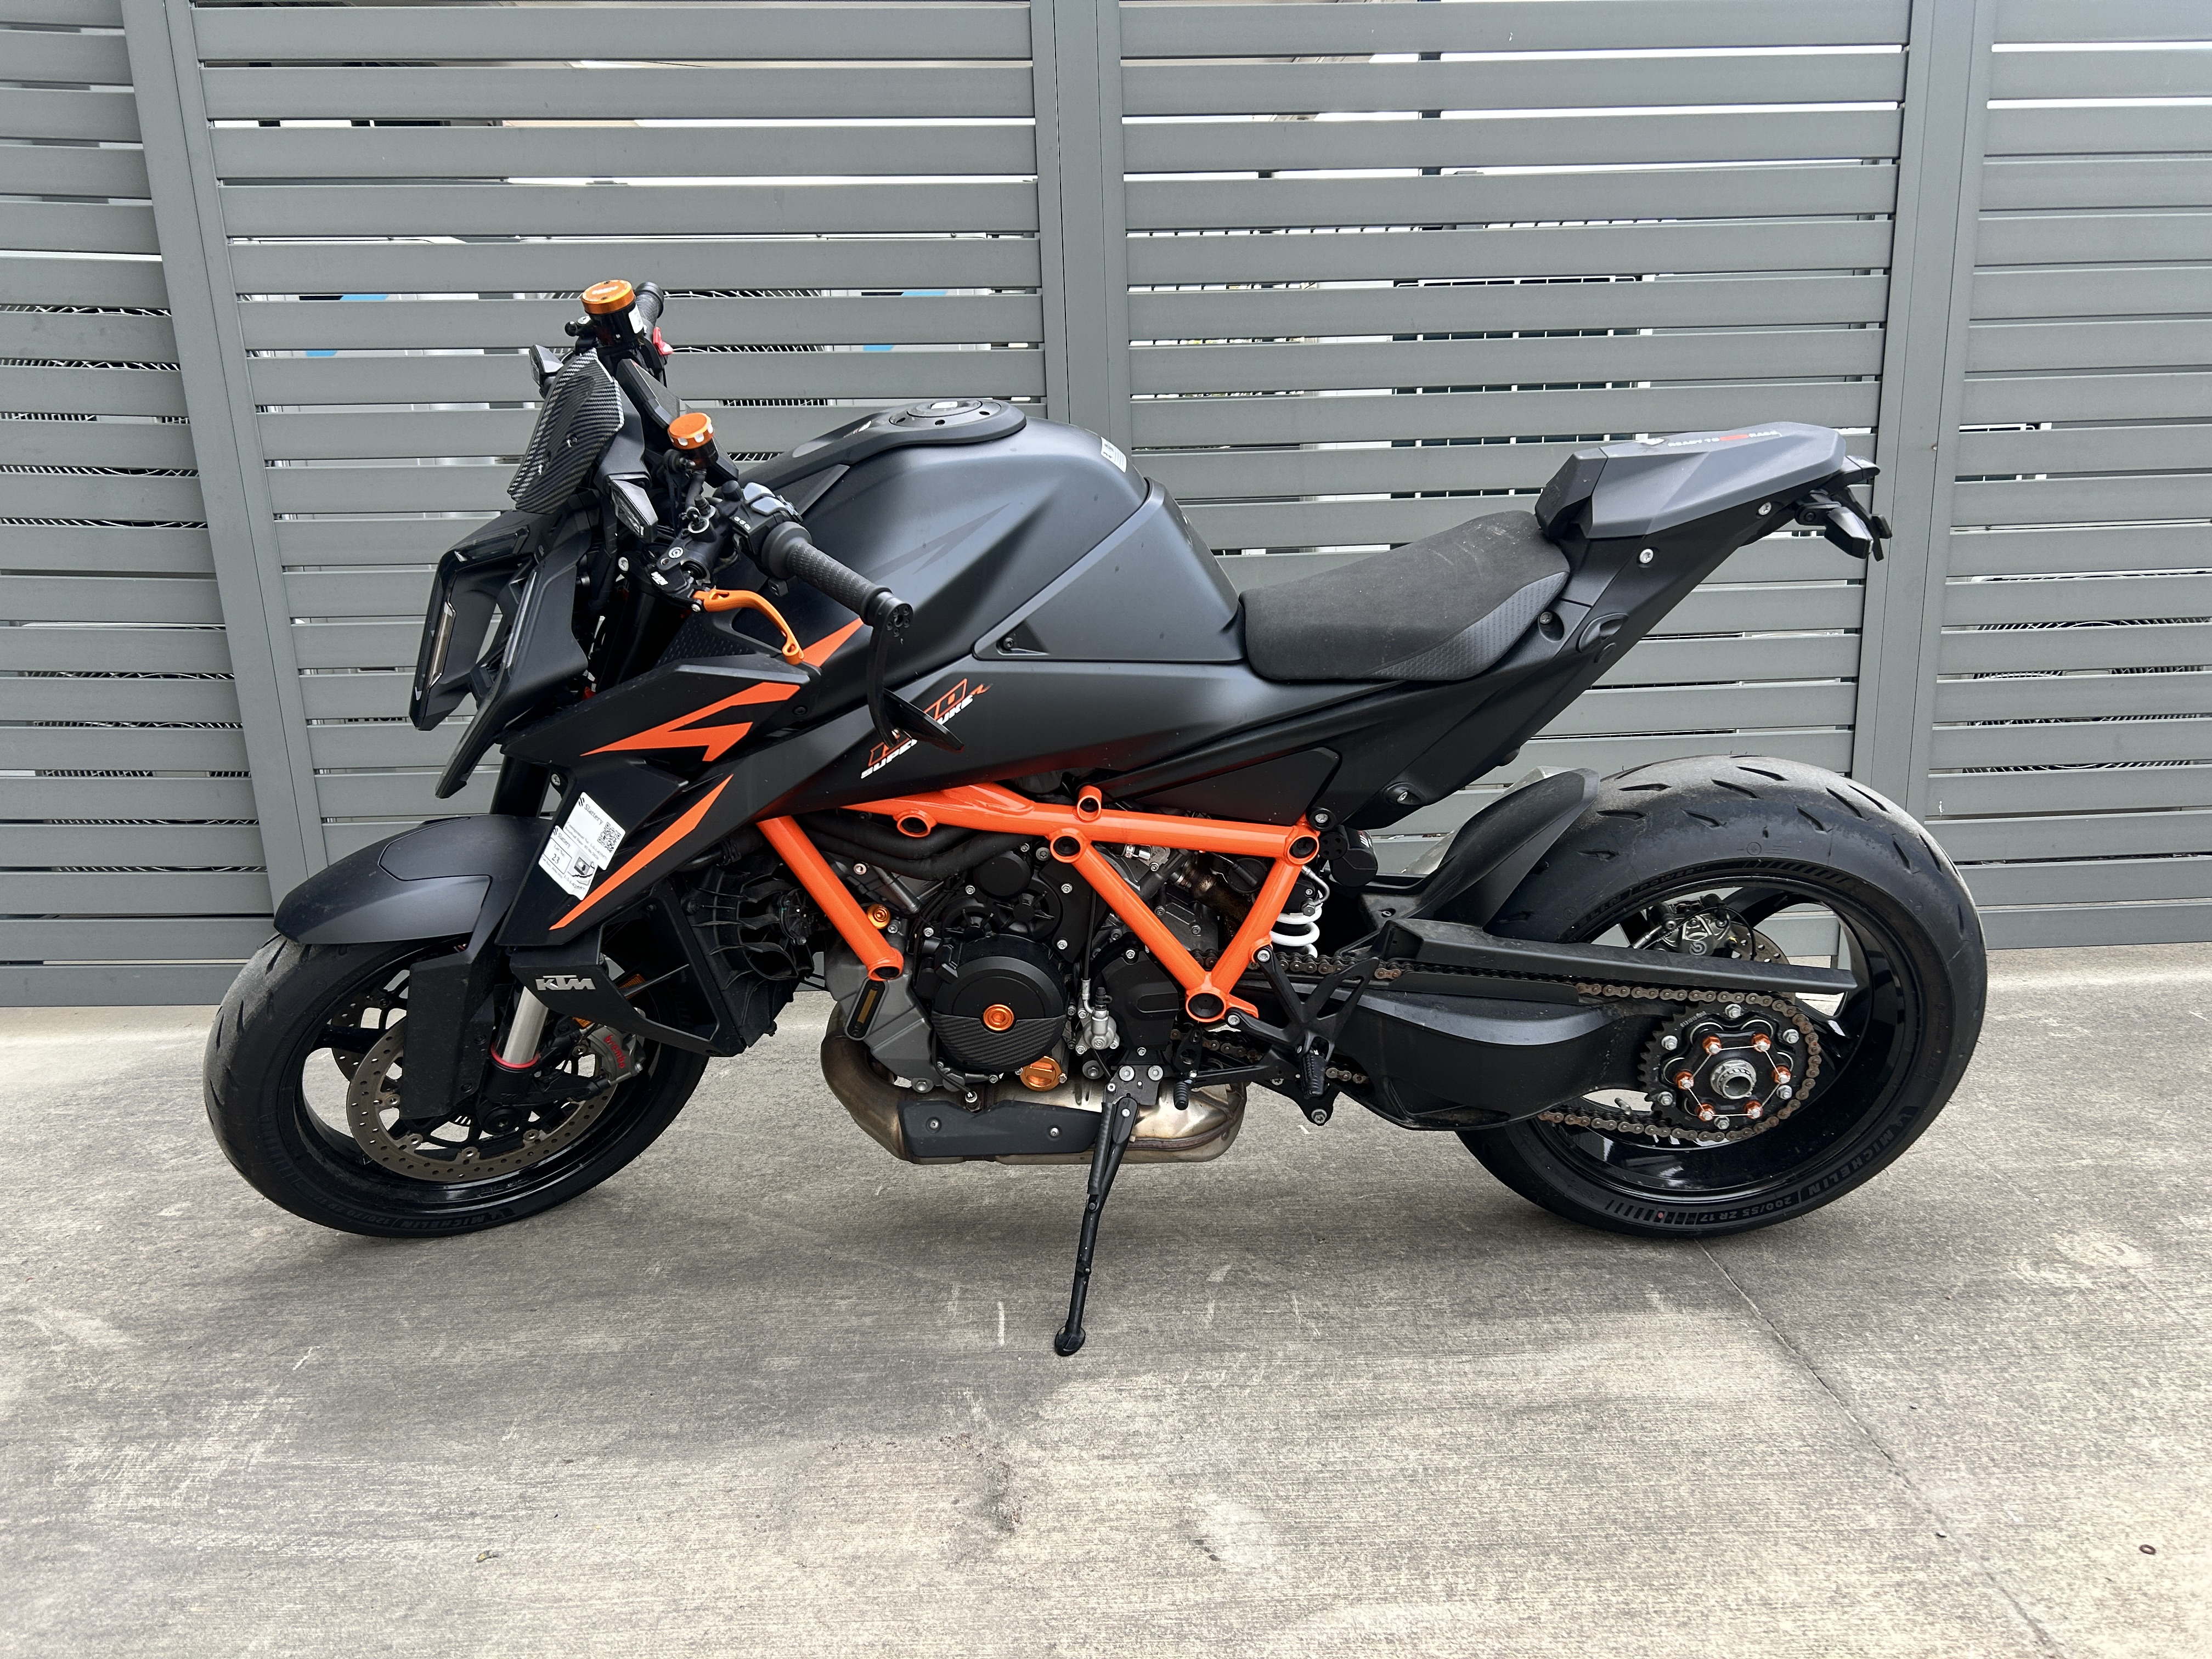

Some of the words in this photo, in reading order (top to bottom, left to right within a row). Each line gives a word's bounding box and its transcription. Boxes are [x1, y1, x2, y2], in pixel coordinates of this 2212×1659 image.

[936, 695, 973, 725] UKE
[584, 803, 604, 826] Slattery
[551, 853, 561, 864] 23
[535, 974, 596, 991] KTM
[603, 1034, 627, 1069] brembo
[1808, 1128, 1895, 1196] MICHELIN
[1742, 1195, 1792, 1217] 200/55
[346, 1210, 391, 1225] 120/70
[400, 1215, 485, 1229] MICHELIN
[1700, 1214, 1716, 1222] 17
[1719, 1211, 1738, 1220] ZR
